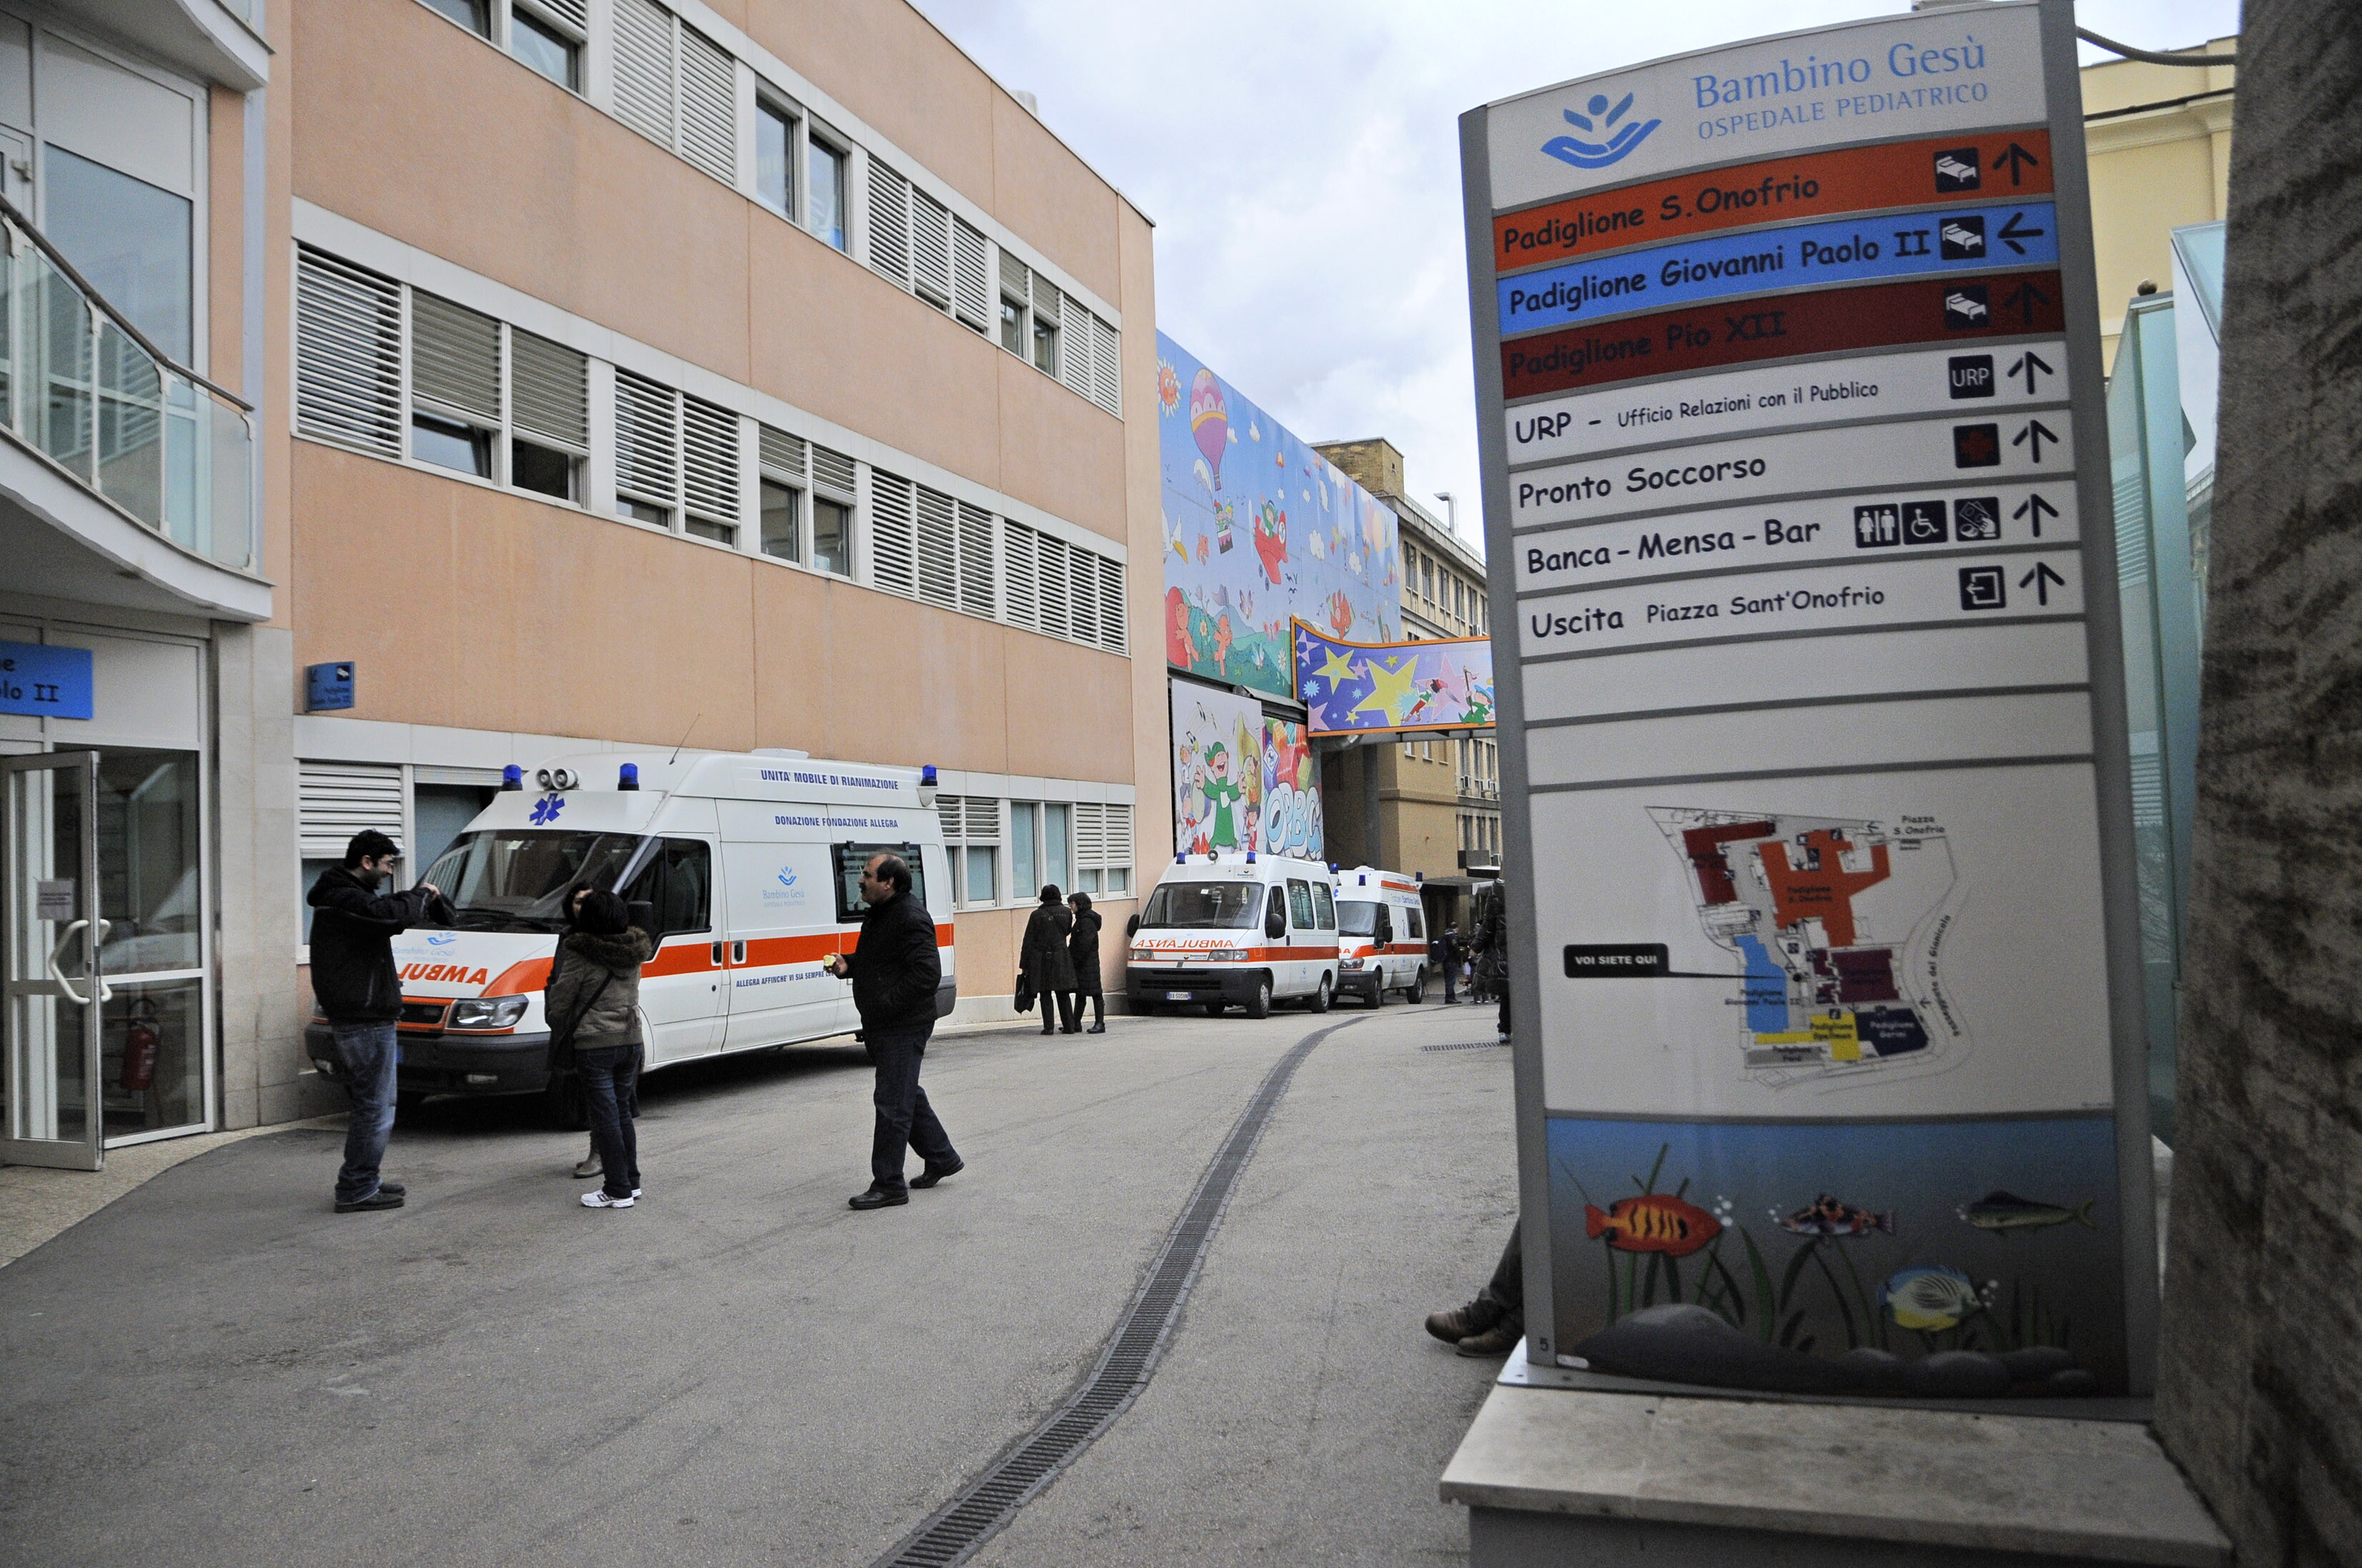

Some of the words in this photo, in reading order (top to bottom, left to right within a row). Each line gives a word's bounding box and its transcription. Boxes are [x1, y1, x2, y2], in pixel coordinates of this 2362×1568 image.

[1693, 55, 1871, 109] Bambino
[1888, 34, 1986, 78] Gesù
[1698, 101, 1826, 140] OSPEDALE
[1837, 82, 1988, 118] PEDIATRICO
[1503, 208, 1645, 253] Padiglione
[1510, 273, 1647, 315] Padiglione
[1660, 244, 1784, 287] Giovanni
[1801, 234, 1880, 268] Paolo
[1893, 229, 1931, 258] II
[1510, 332, 1651, 378] Padiglione
[1666, 320, 1712, 351] Pio
[1724, 309, 1787, 343] XII
[1951, 366, 1990, 388] URP
[1515, 411, 1572, 444] URP
[1617, 407, 1673, 428] Ufficio
[1679, 396, 1751, 418] Relazioni
[1758, 393, 1786, 408] con
[1793, 386, 1803, 404] il
[1810, 381, 1879, 402] Pubblico
[1519, 476, 1612, 508] Pronto
[1626, 458, 1766, 493] Soccorso
[1531, 608, 1624, 638] Uscita
[1646, 603, 1719, 623] Piazza
[1730, 586, 1886, 615] Sant'Onofrio
[34, 683, 59, 703] II
[761, 769, 791, 782] UNITA'
[794, 773, 827, 785] MOBILE
[831, 775, 839, 785] DI
[841, 776, 899, 790] RIANIMAZIONE
[775, 815, 820, 826] DONAZIONE
[822, 818, 868, 828] FONDAZIONE
[870, 819, 899, 828] ALLEGRA
[1901, 815, 1936, 824] Piazza
[1906, 825, 1946, 835] Onofrio
[1575, 955, 1596, 965] VOI
[1598, 955, 1633, 965] SIETE
[1635, 955, 1658, 964] QUI
[736, 978, 760, 988] ALLEGRA
[805, 971, 824, 980] SEMPRE
[1539, 1337, 1548, 1352] 5
